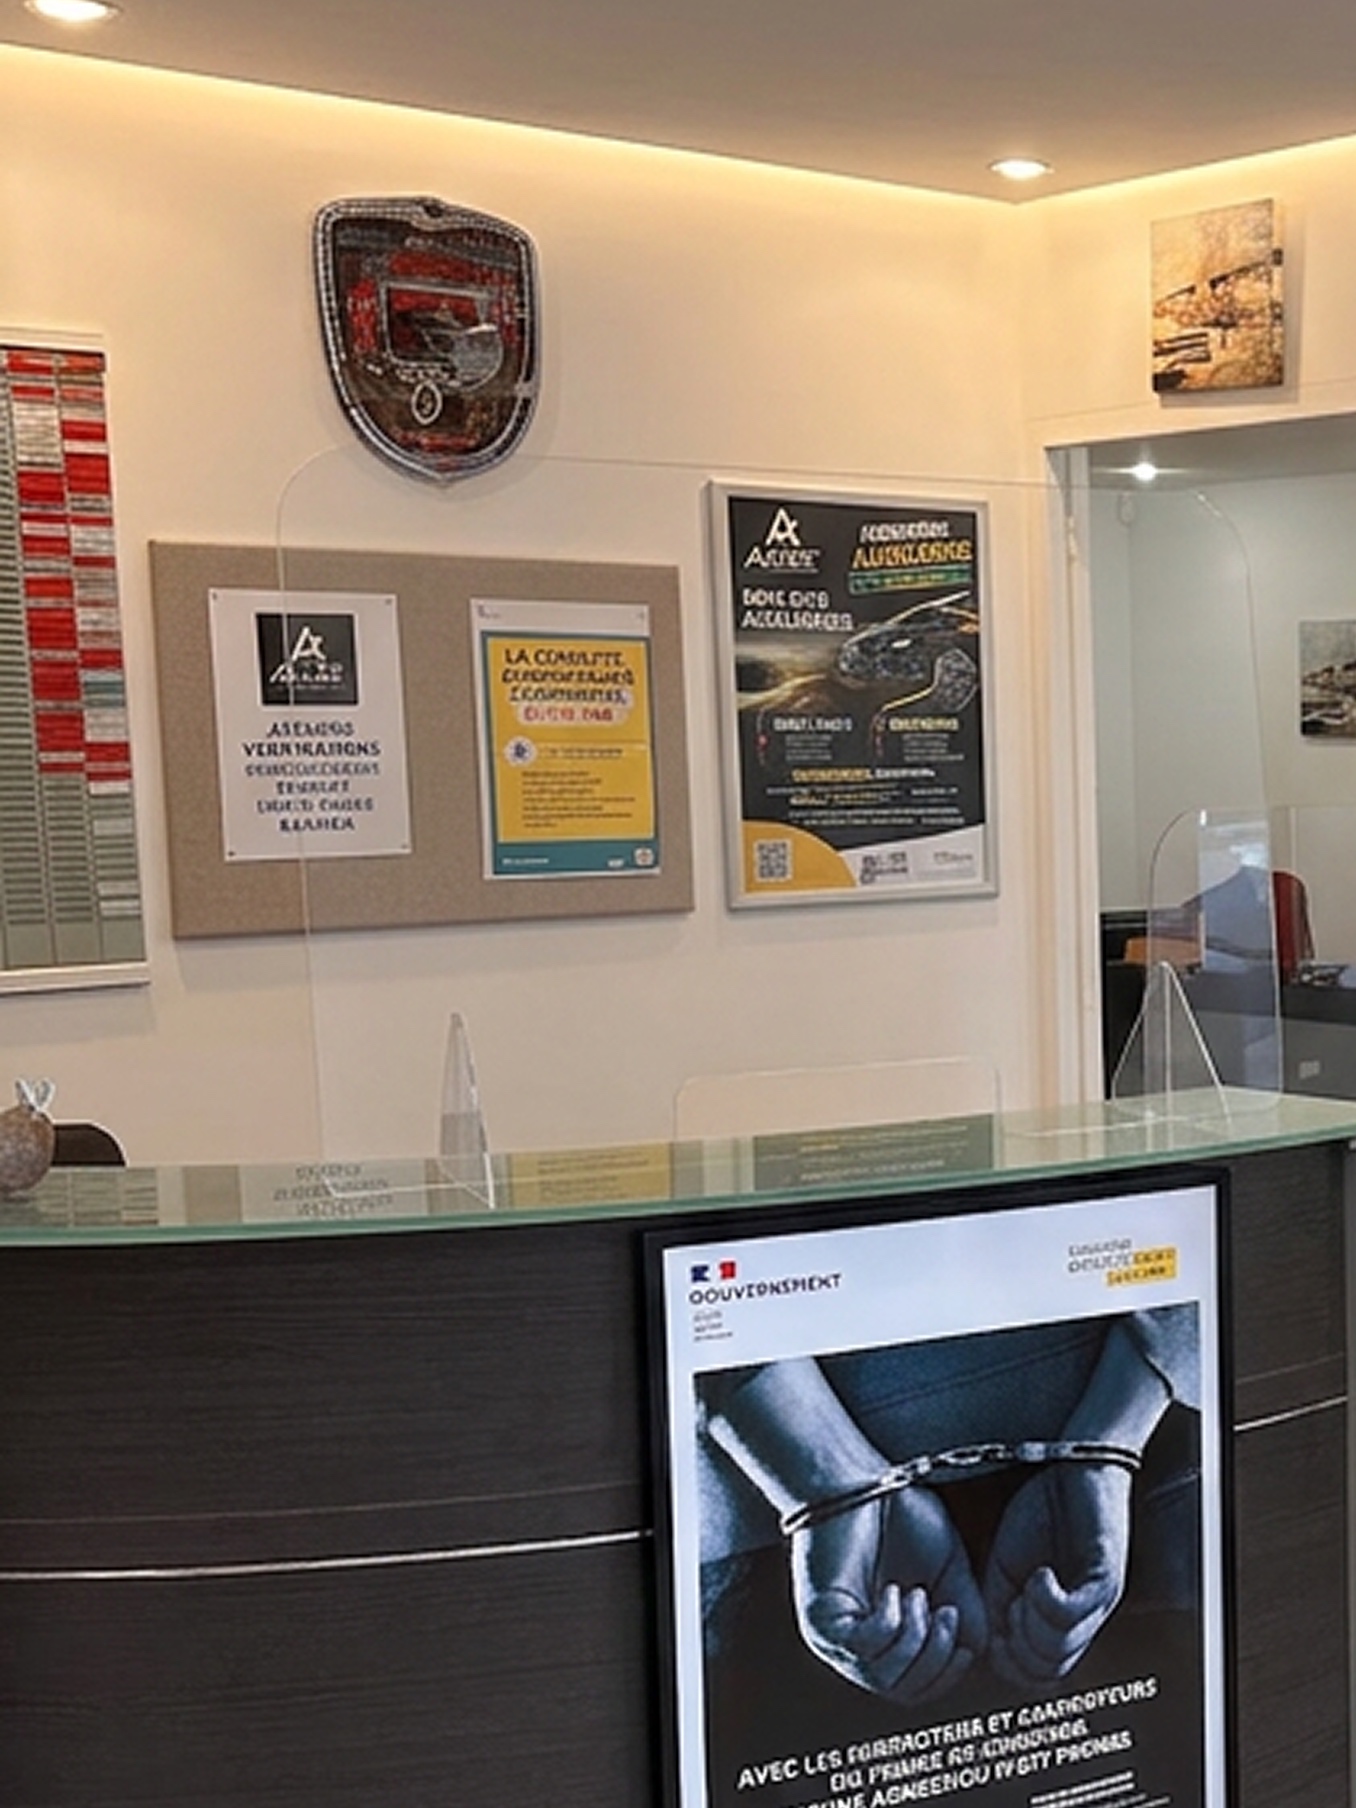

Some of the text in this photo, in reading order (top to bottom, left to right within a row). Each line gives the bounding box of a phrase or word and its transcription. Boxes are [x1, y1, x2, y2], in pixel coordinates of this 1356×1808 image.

[737, 1758, 799, 1790] AVEC
[804, 1750, 843, 1775] LES
[988, 1711, 1013, 1734] ET
